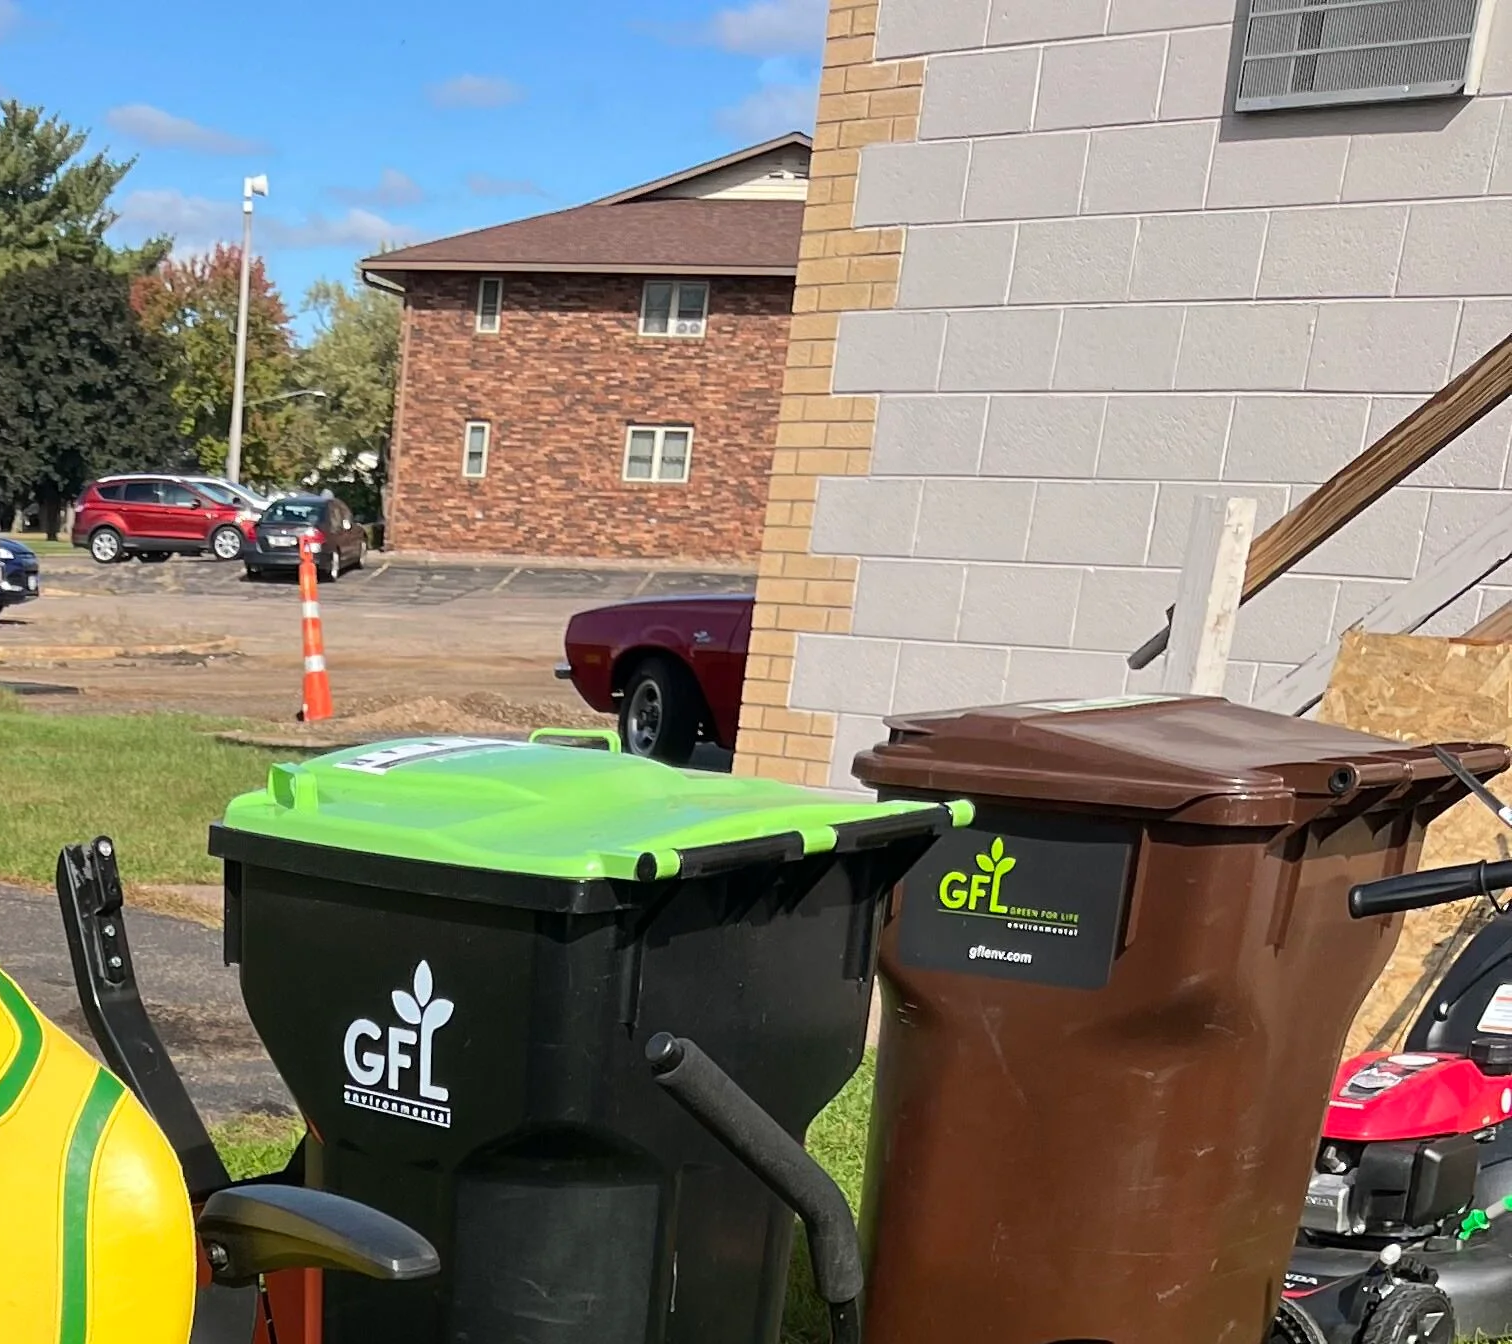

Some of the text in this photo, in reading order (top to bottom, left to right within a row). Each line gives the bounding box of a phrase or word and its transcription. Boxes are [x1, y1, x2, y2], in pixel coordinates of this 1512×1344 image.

[939, 857, 1079, 923] GFL GREEN FOR LIFE
[1007, 922, 1078, 937] environmental
[968, 945, 1033, 964] gflenv.com
[344, 999, 454, 1102] GFL
[344, 1090, 451, 1125] environmental
